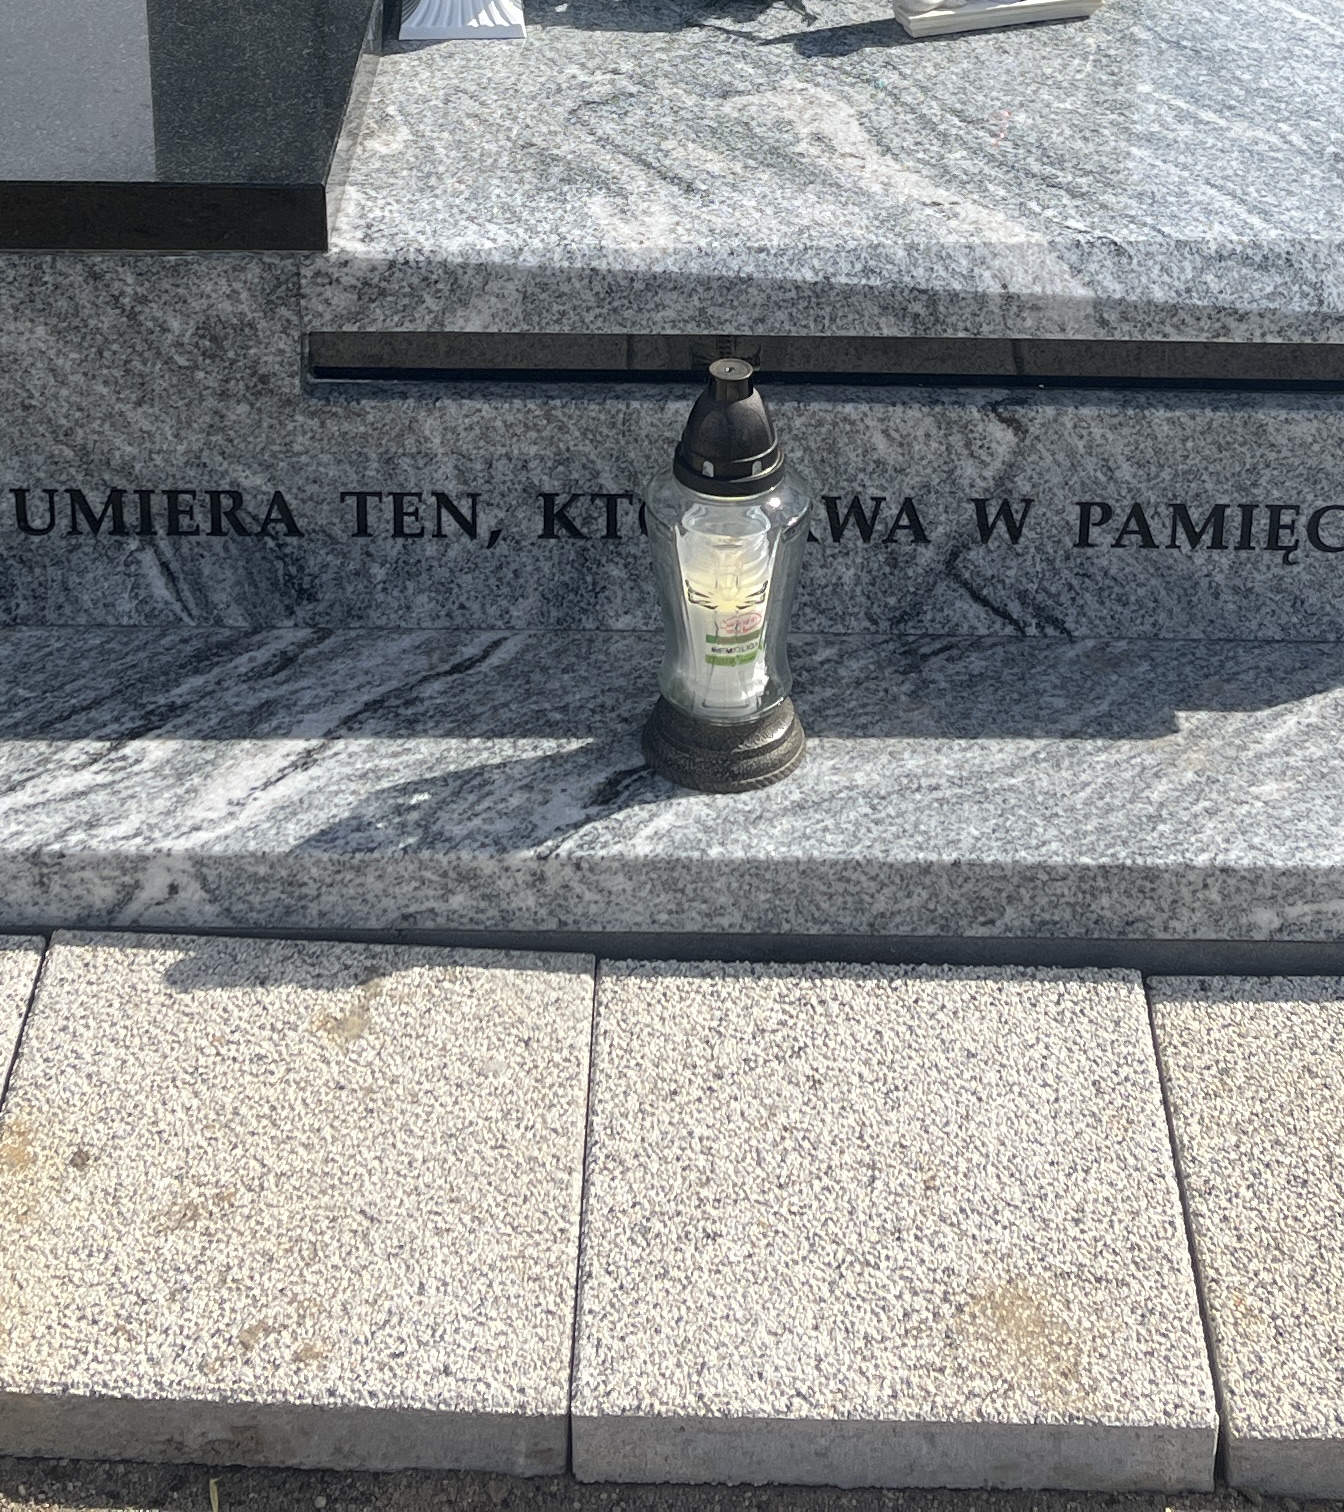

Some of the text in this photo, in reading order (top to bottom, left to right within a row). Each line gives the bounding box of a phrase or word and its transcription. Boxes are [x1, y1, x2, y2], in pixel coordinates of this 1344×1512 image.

[9, 488, 305, 538] UMIERA
[339, 491, 504, 549] TEN,
[537, 492, 649, 540] KT
[968, 497, 1035, 545] W
